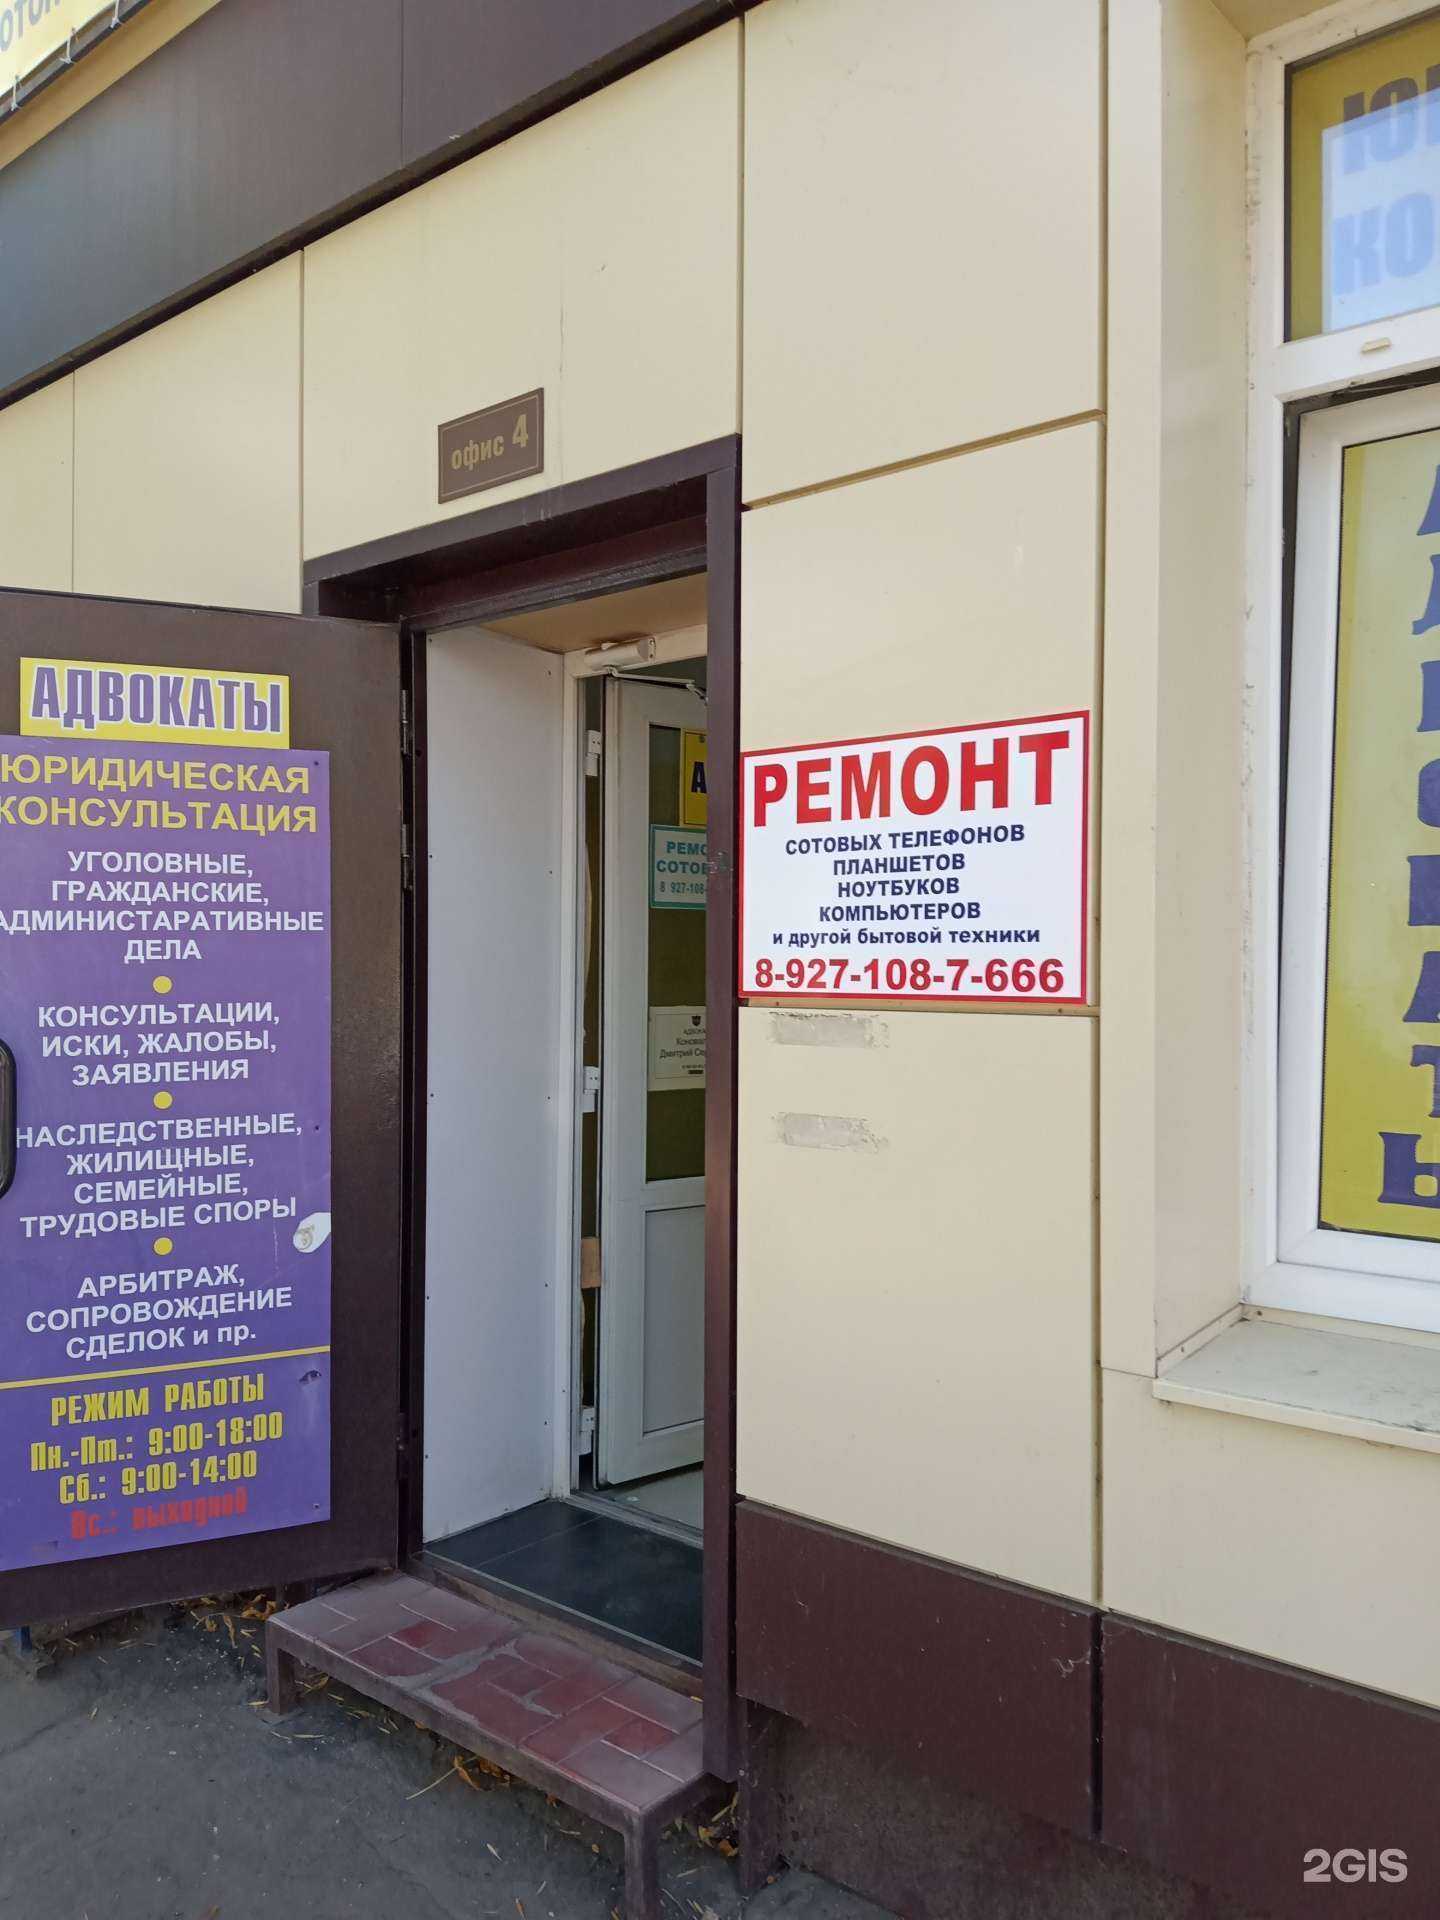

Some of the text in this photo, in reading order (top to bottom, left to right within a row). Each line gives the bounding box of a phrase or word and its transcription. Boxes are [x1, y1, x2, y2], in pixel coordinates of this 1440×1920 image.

[452, 414, 528, 471] офис 4
[30, 665, 282, 733] АДВОКАТЫ
[1, 754, 310, 794] ЮРИДИЧЕСКАЯ
[754, 730, 1069, 827] РЕМОНТ
[0, 796, 317, 836] КОНСУЛЬТАЦИЯ
[785, 824, 1025, 856] СОТОВЫХ ТЕЛЕФОНОВ
[68, 851, 253, 877] УГОЛОВНЫЕ,
[833, 853, 965, 876] ПЛАНШЕТОВ
[52, 880, 269, 906] ГРАЖДАНСКИЕ,
[837, 877, 960, 898] НОУТБУКОВ
[819, 902, 981, 922] КОМПЬЮТЕРОВ
[124, 939, 202, 963] ДЕЛА
[772, 927, 1041, 948] и другой бытовой техники
[755, 958, 1065, 993] 8-927-108-7-666
[38, 1001, 279, 1027] КОНСУЛЬТАЦИИ,
[42, 1030, 276, 1058] ИСКИ, ЖАЛОБЫ,
[72, 1059, 249, 1086] ЗАЯВЛЕНИЯ
[17, 1113, 302, 1148] НАСЛЕДСТВЕННЫЕ,
[66, 1144, 254, 1175] ЖИЛИЩНЫЕ,
[74, 1173, 248, 1204] СЕМЕЙНЫЕ,
[20, 1197, 296, 1238] ТРУДОВЫЕ СПОРЫ
[77, 1264, 245, 1298] АРБИТРАЖ,
[26, 1287, 292, 1333] СОПРОВОЖДЕНИЕ
[66, 1325, 256, 1361] СДЕЛОК и пр.
[51, 1373, 264, 1426] РЕЖИМ РАБОТЫ
[149, 1411, 283, 1456] 9:00-18:00
[59, 1450, 257, 1504] Сб.: 9:00-14:00
